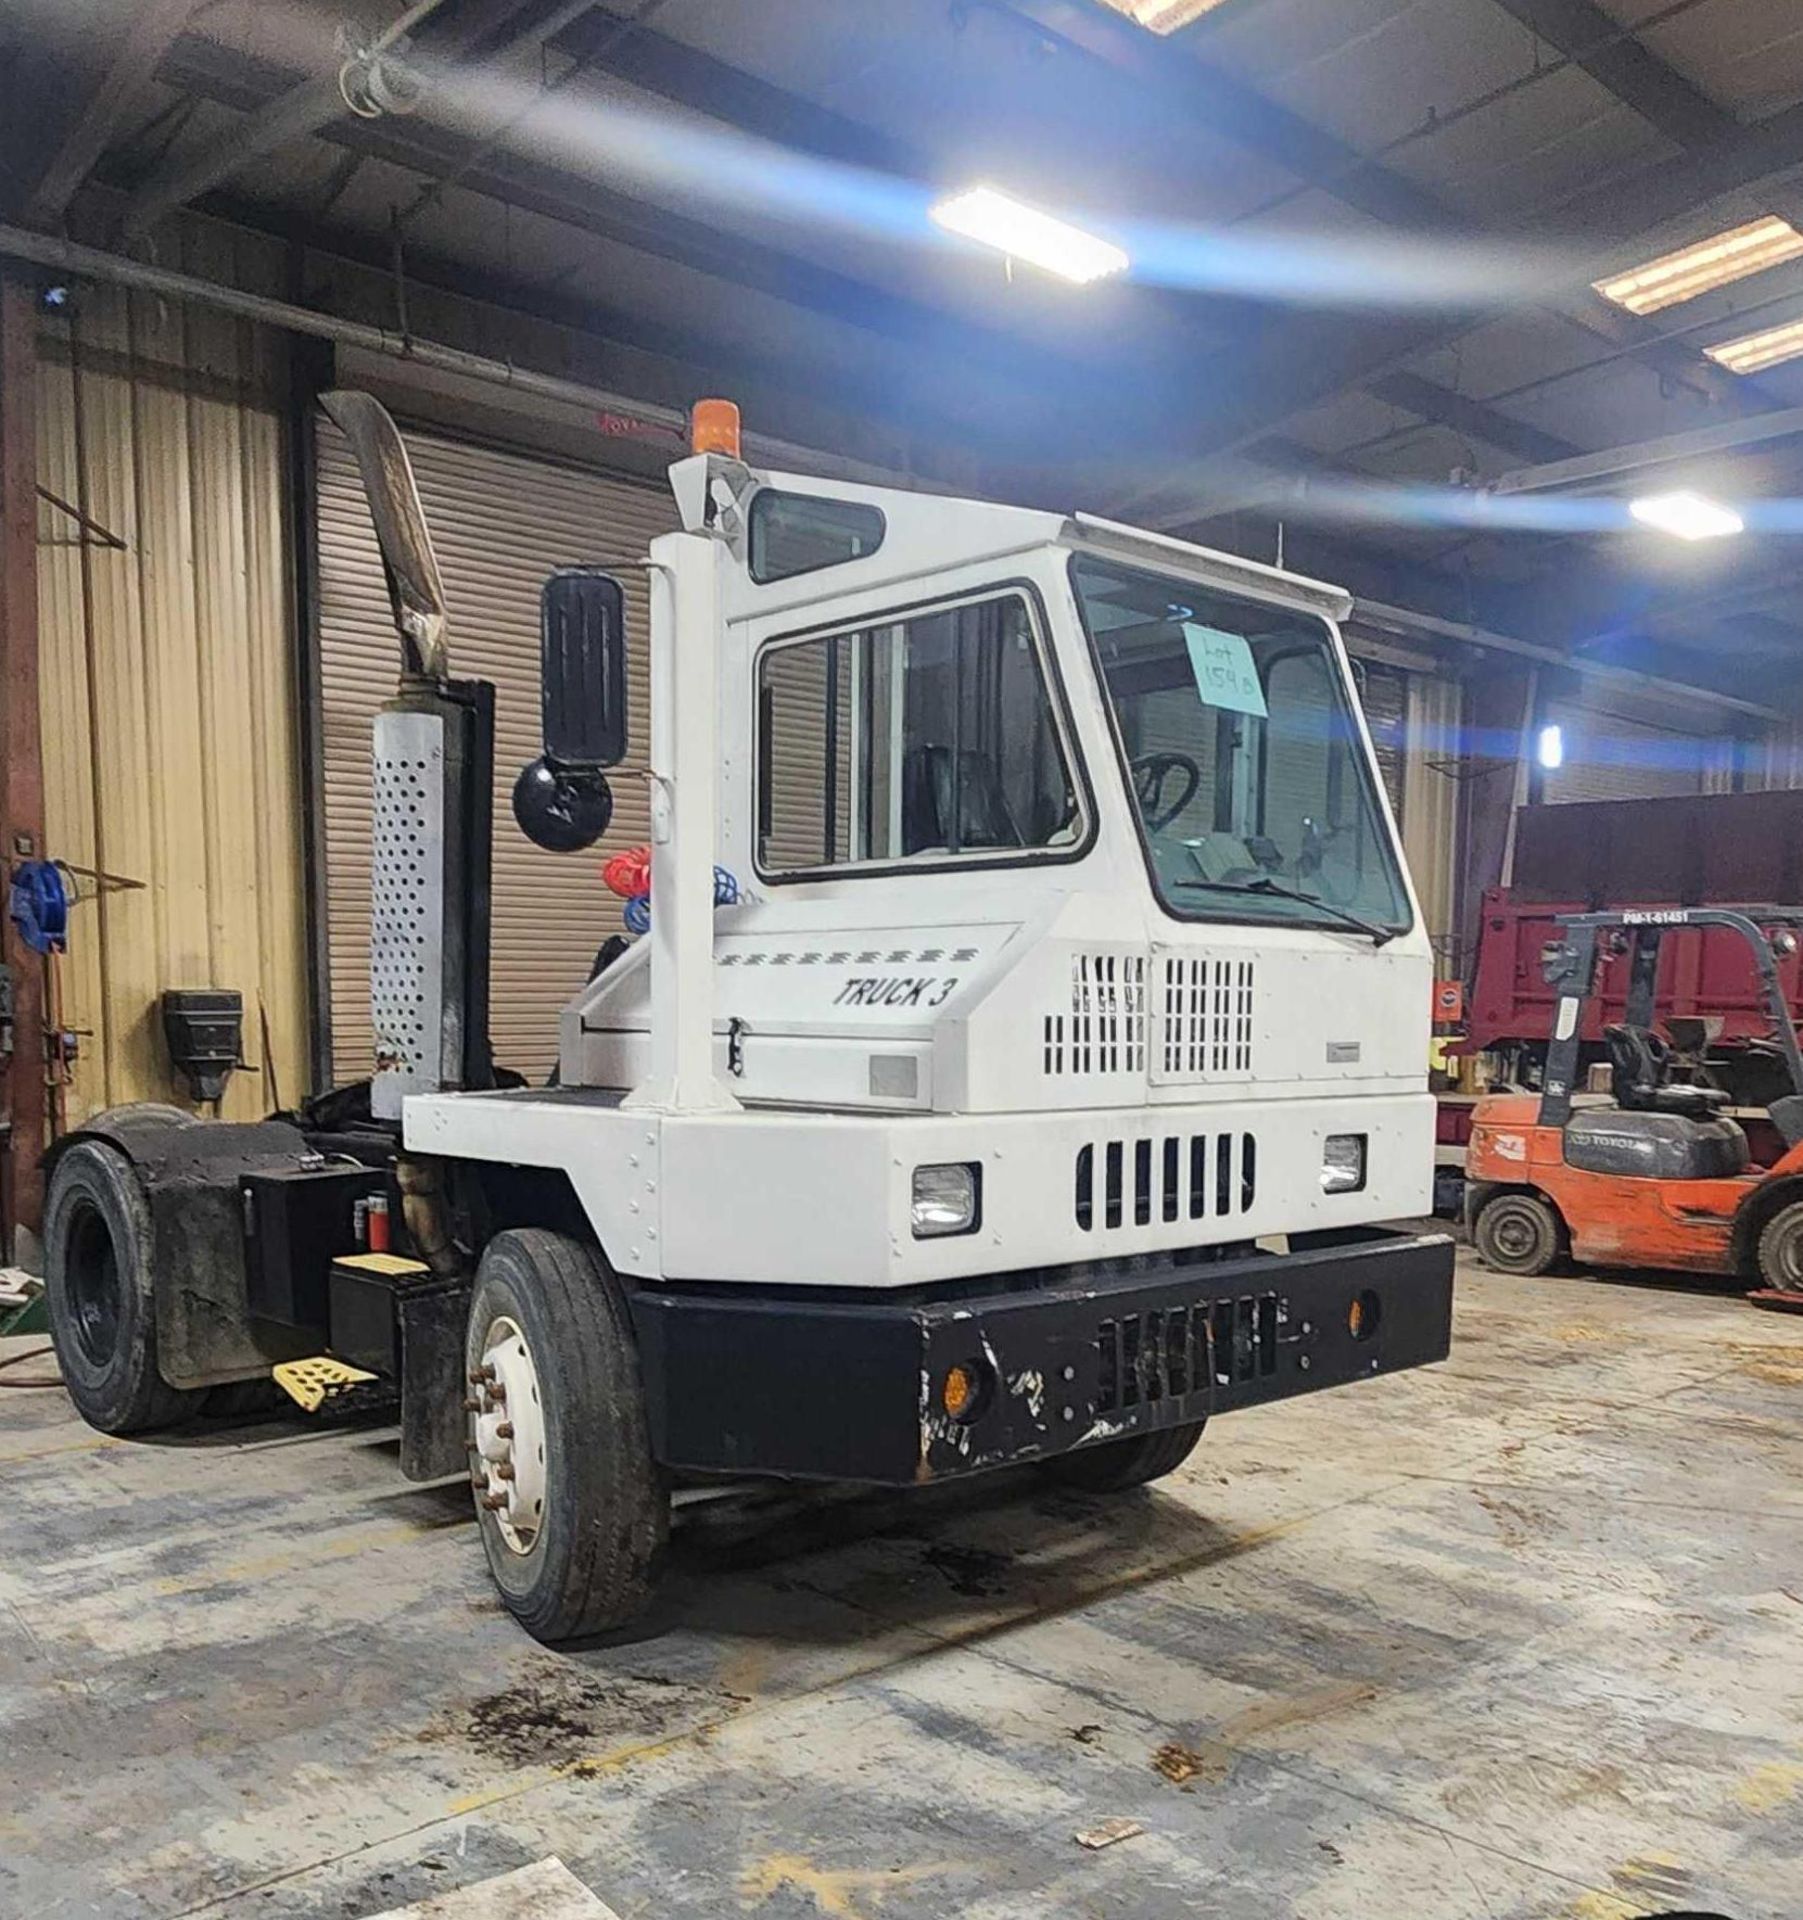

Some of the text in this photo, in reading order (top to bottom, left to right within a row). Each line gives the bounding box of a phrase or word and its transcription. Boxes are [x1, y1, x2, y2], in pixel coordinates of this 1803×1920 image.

[1203, 636, 1233, 664] Lot
[833, 977, 959, 1007] TRUCK 3
